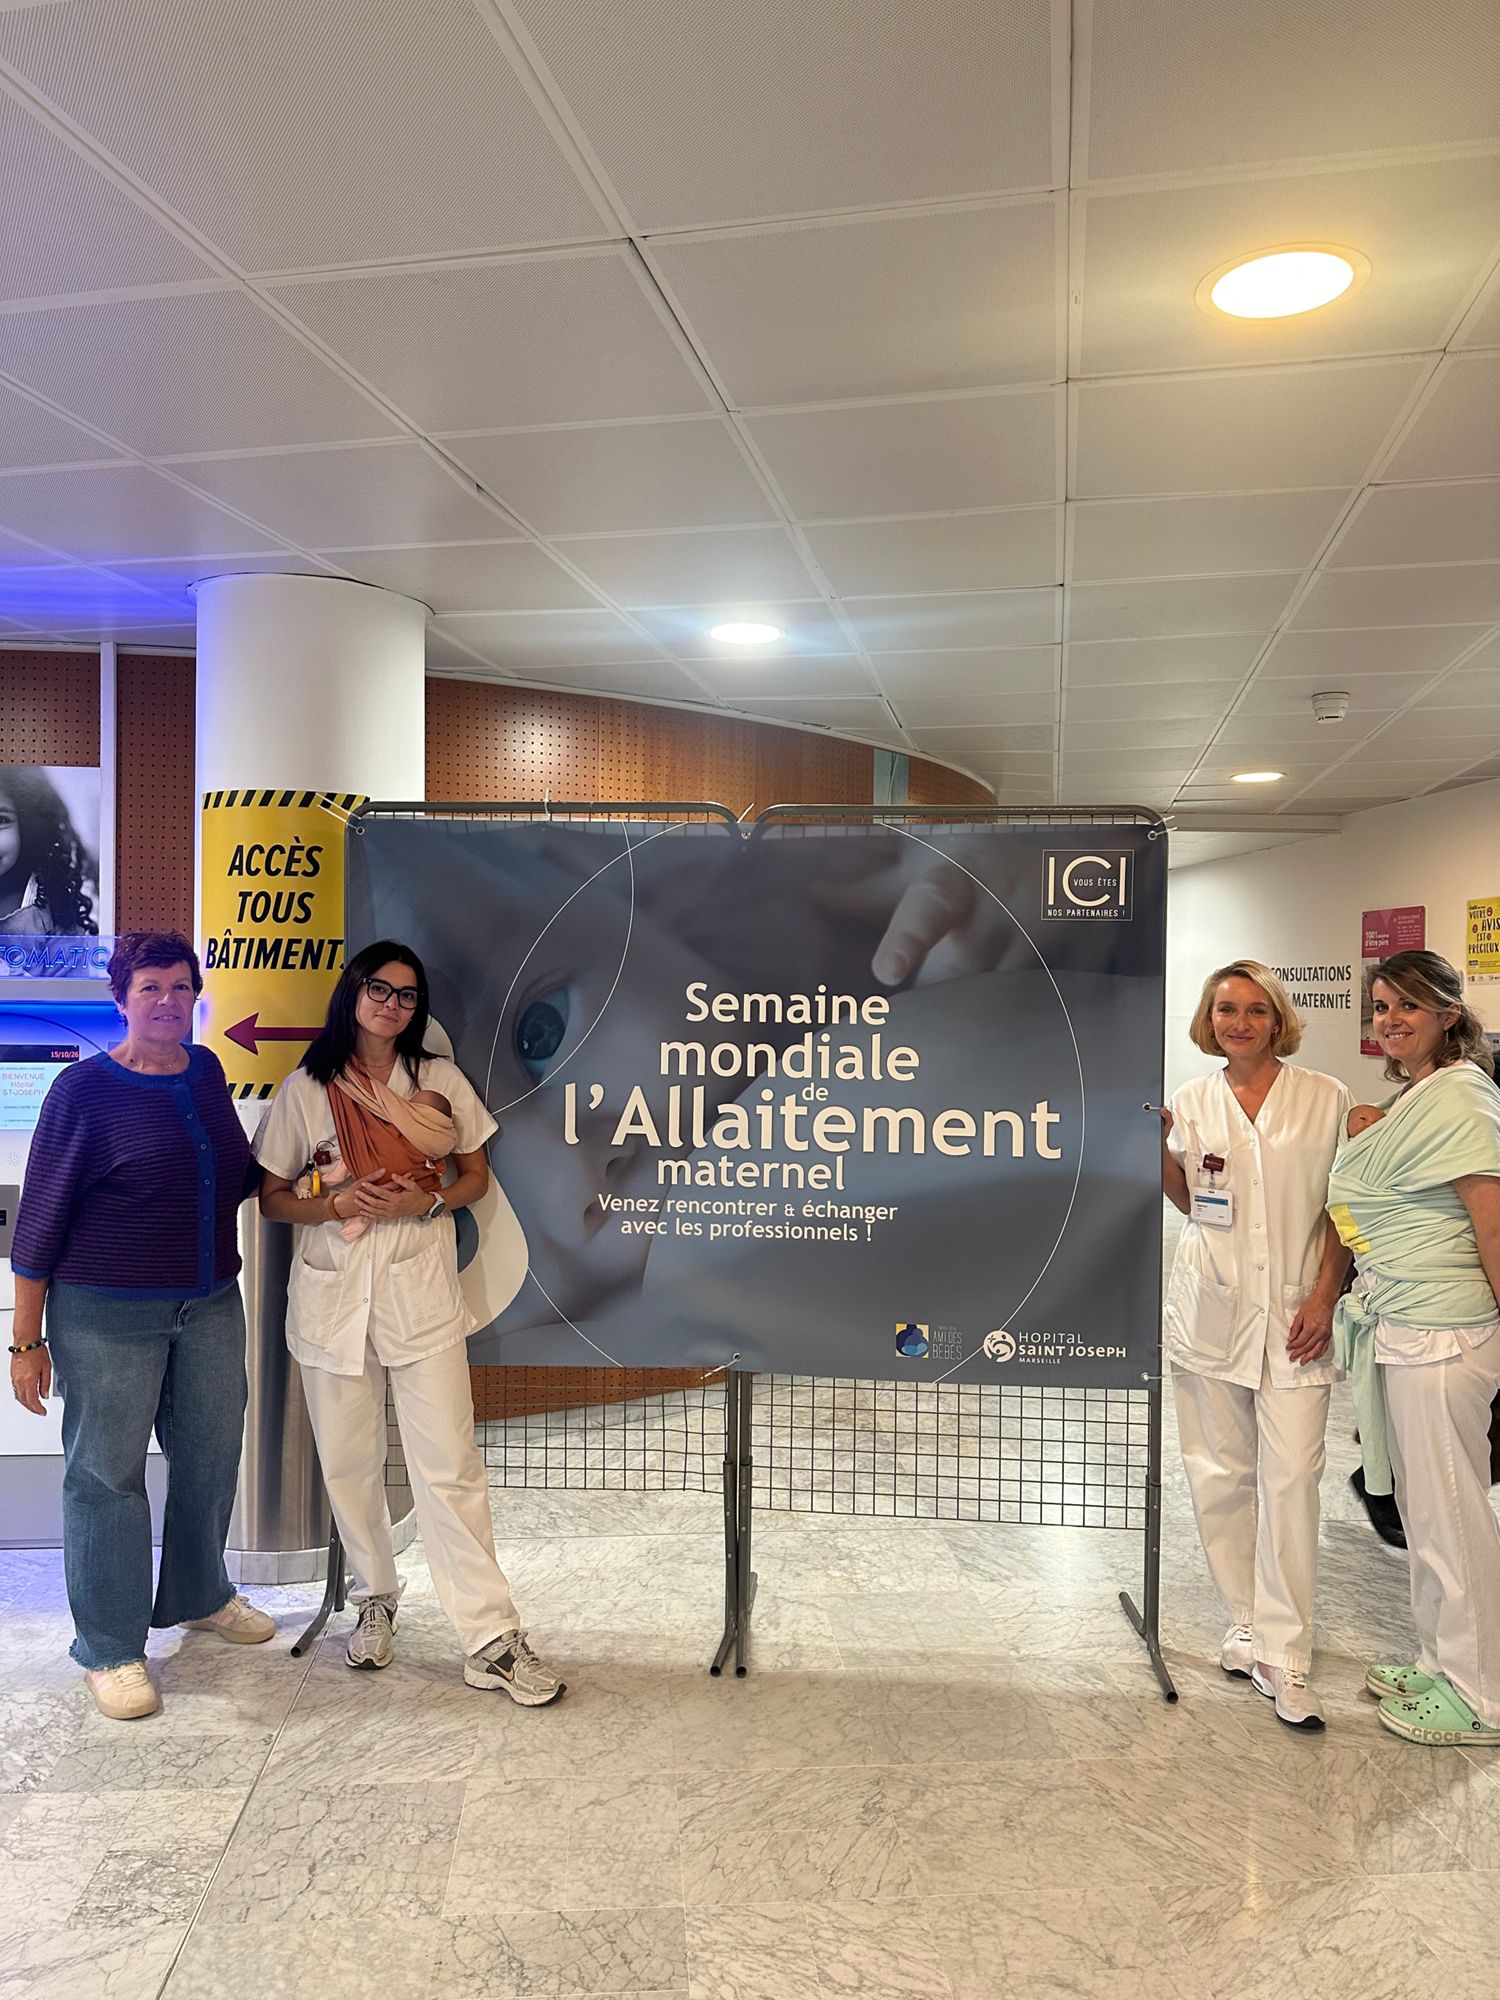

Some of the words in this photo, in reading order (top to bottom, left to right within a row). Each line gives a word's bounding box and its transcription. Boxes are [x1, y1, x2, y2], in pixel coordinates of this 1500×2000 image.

[227, 836, 324, 877] ACCÈS
[1048, 855, 1127, 907] ICI
[1073, 878, 1094, 887] VOUS
[1097, 877, 1117, 887] ÊTES
[237, 890, 316, 924] TOUS
[1047, 909, 1063, 917] NOS
[1066, 909, 1119, 917] PARTENAIRES
[685, 981, 890, 1026] Semaine
[1292, 989, 1352, 1009] MATERNITÉ
[659, 1031, 920, 1081] mondiale
[801, 1083, 829, 1102] de
[657, 1154, 846, 1191] maternel
[598, 1193, 661, 1214] Venez
[666, 1197, 777, 1216] rencontrer
[784, 1203, 796, 1217] &
[802, 1199, 899, 1224] échanger
[620, 1219, 670, 1236] avec
[675, 1217, 704, 1237] les
[709, 1220, 859, 1242] professionnels
[865, 1224, 873, 1243] !
[1411, 1726, 1463, 1742] crocs
